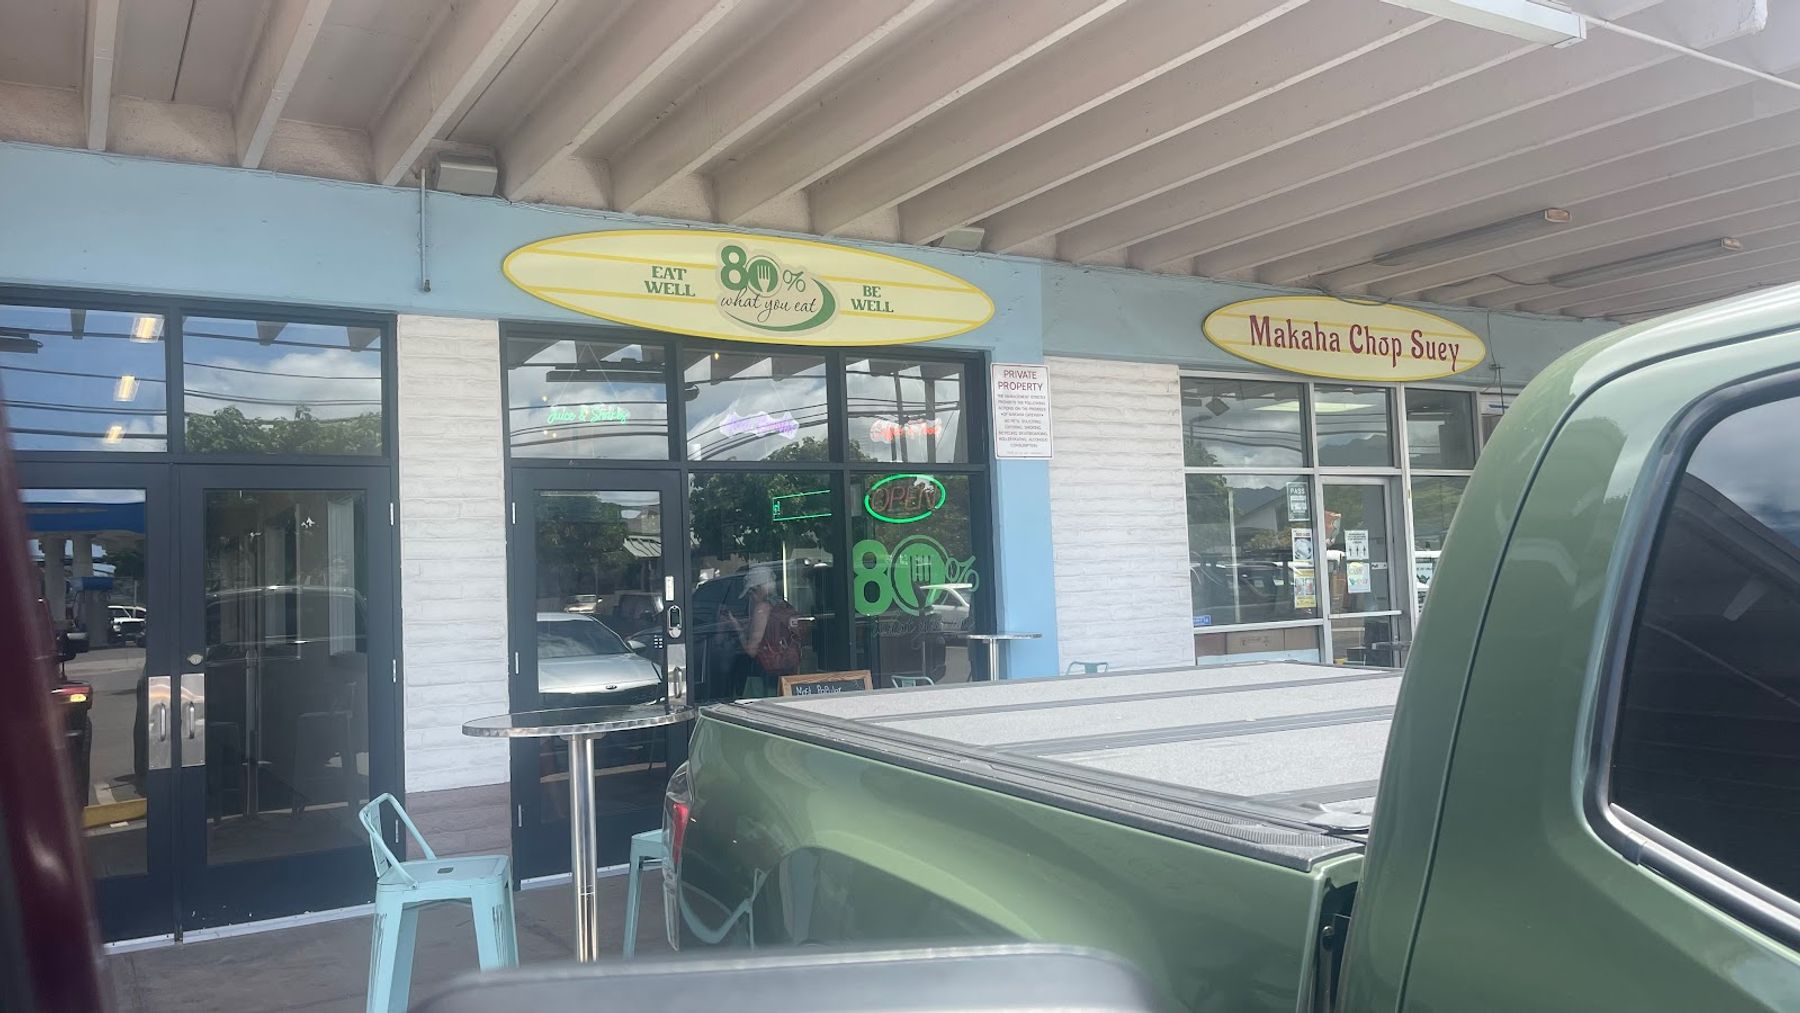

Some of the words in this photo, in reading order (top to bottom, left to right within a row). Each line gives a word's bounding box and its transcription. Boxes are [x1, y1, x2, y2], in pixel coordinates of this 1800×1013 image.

[651, 265, 688, 281] EAT
[644, 280, 696, 297] WELL
[863, 285, 881, 298] BE
[721, 287, 761, 309] what
[757, 299, 791, 322] you
[794, 298, 818, 313] eat
[850, 298, 894, 313] WELL
[1249, 315, 1341, 353] Makaha
[1349, 324, 1402, 368] Chop
[1410, 329, 1460, 372] Suey
[1003, 370, 1037, 380] PRIVATE
[998, 381, 1043, 391] PROPERTY
[1290, 487, 1306, 495] PASS
[872, 486, 937, 513] OPEN
